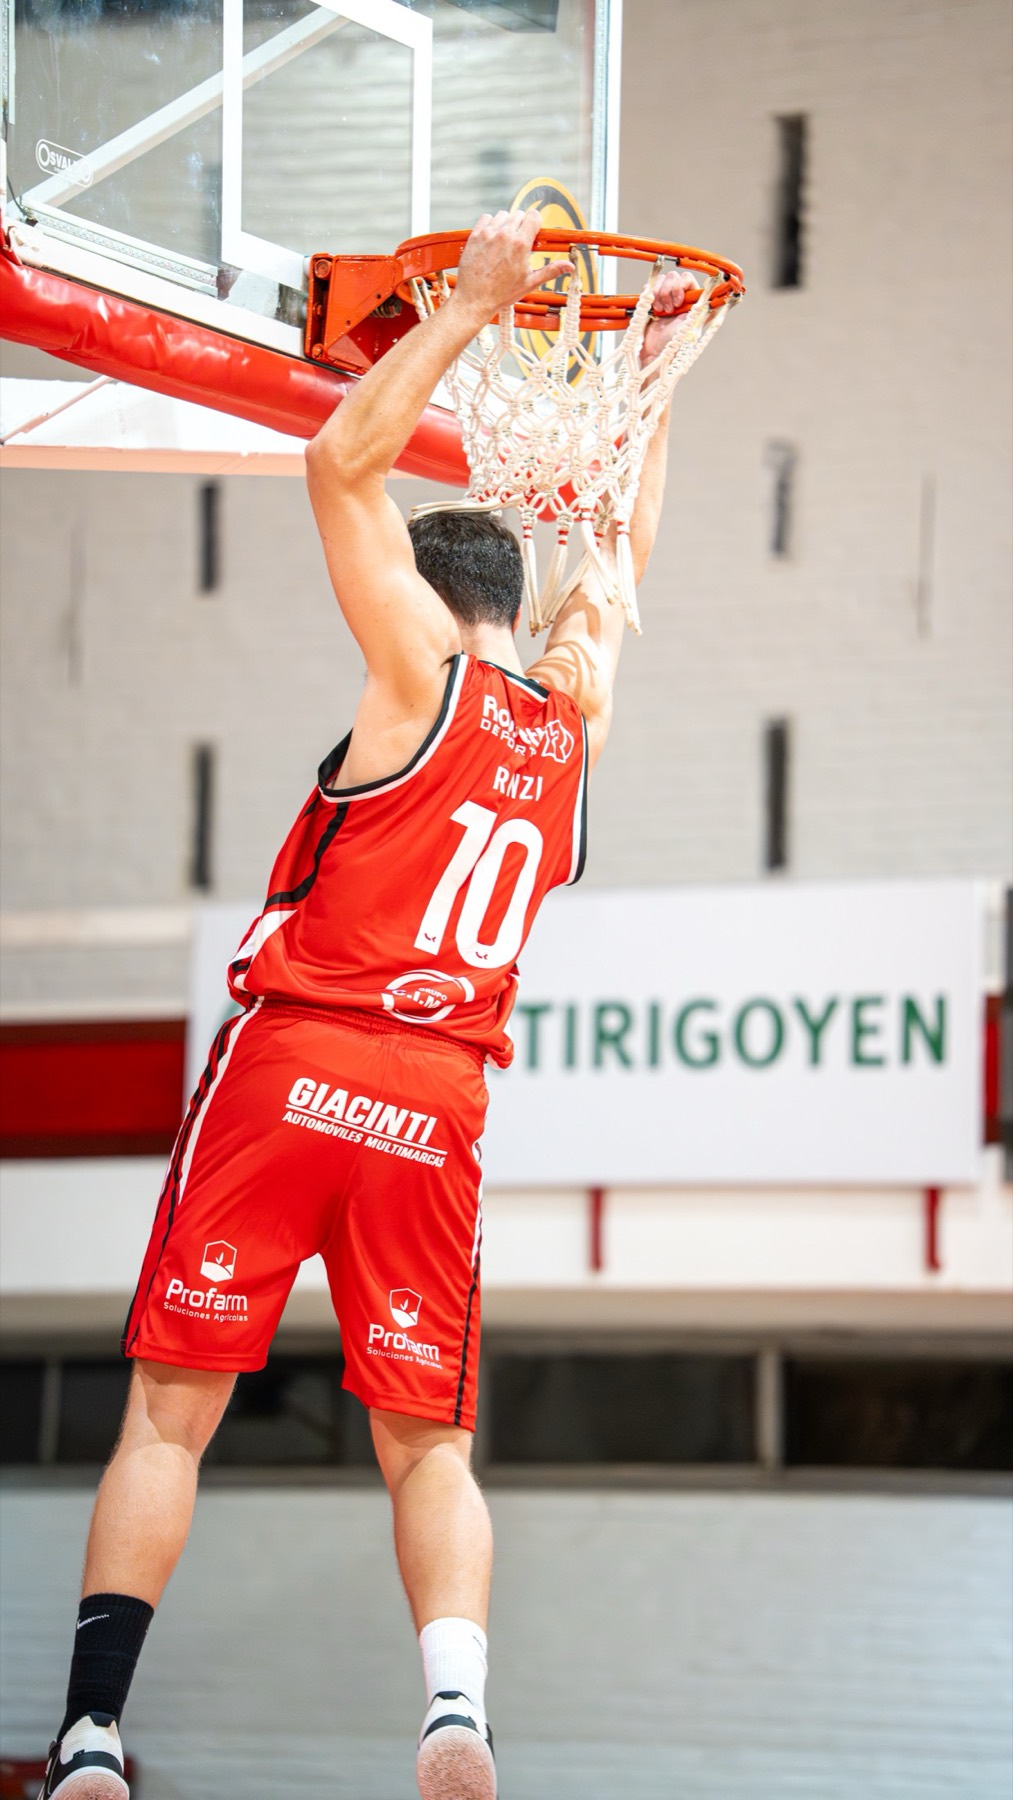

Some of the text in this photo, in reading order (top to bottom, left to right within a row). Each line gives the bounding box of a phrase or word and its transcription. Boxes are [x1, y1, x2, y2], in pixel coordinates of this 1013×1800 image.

[413, 800, 544, 969] 10
[516, 993, 949, 1071] TIRIGOYEN
[281, 1108, 448, 1169] AUTOMÓVILES MULTIMARCAS
[288, 1077, 438, 1145] GIACINTI
[163, 1301, 211, 1320] Soluciones
[165, 1278, 249, 1312] Profarm
[366, 1346, 414, 1362] Soluciones
